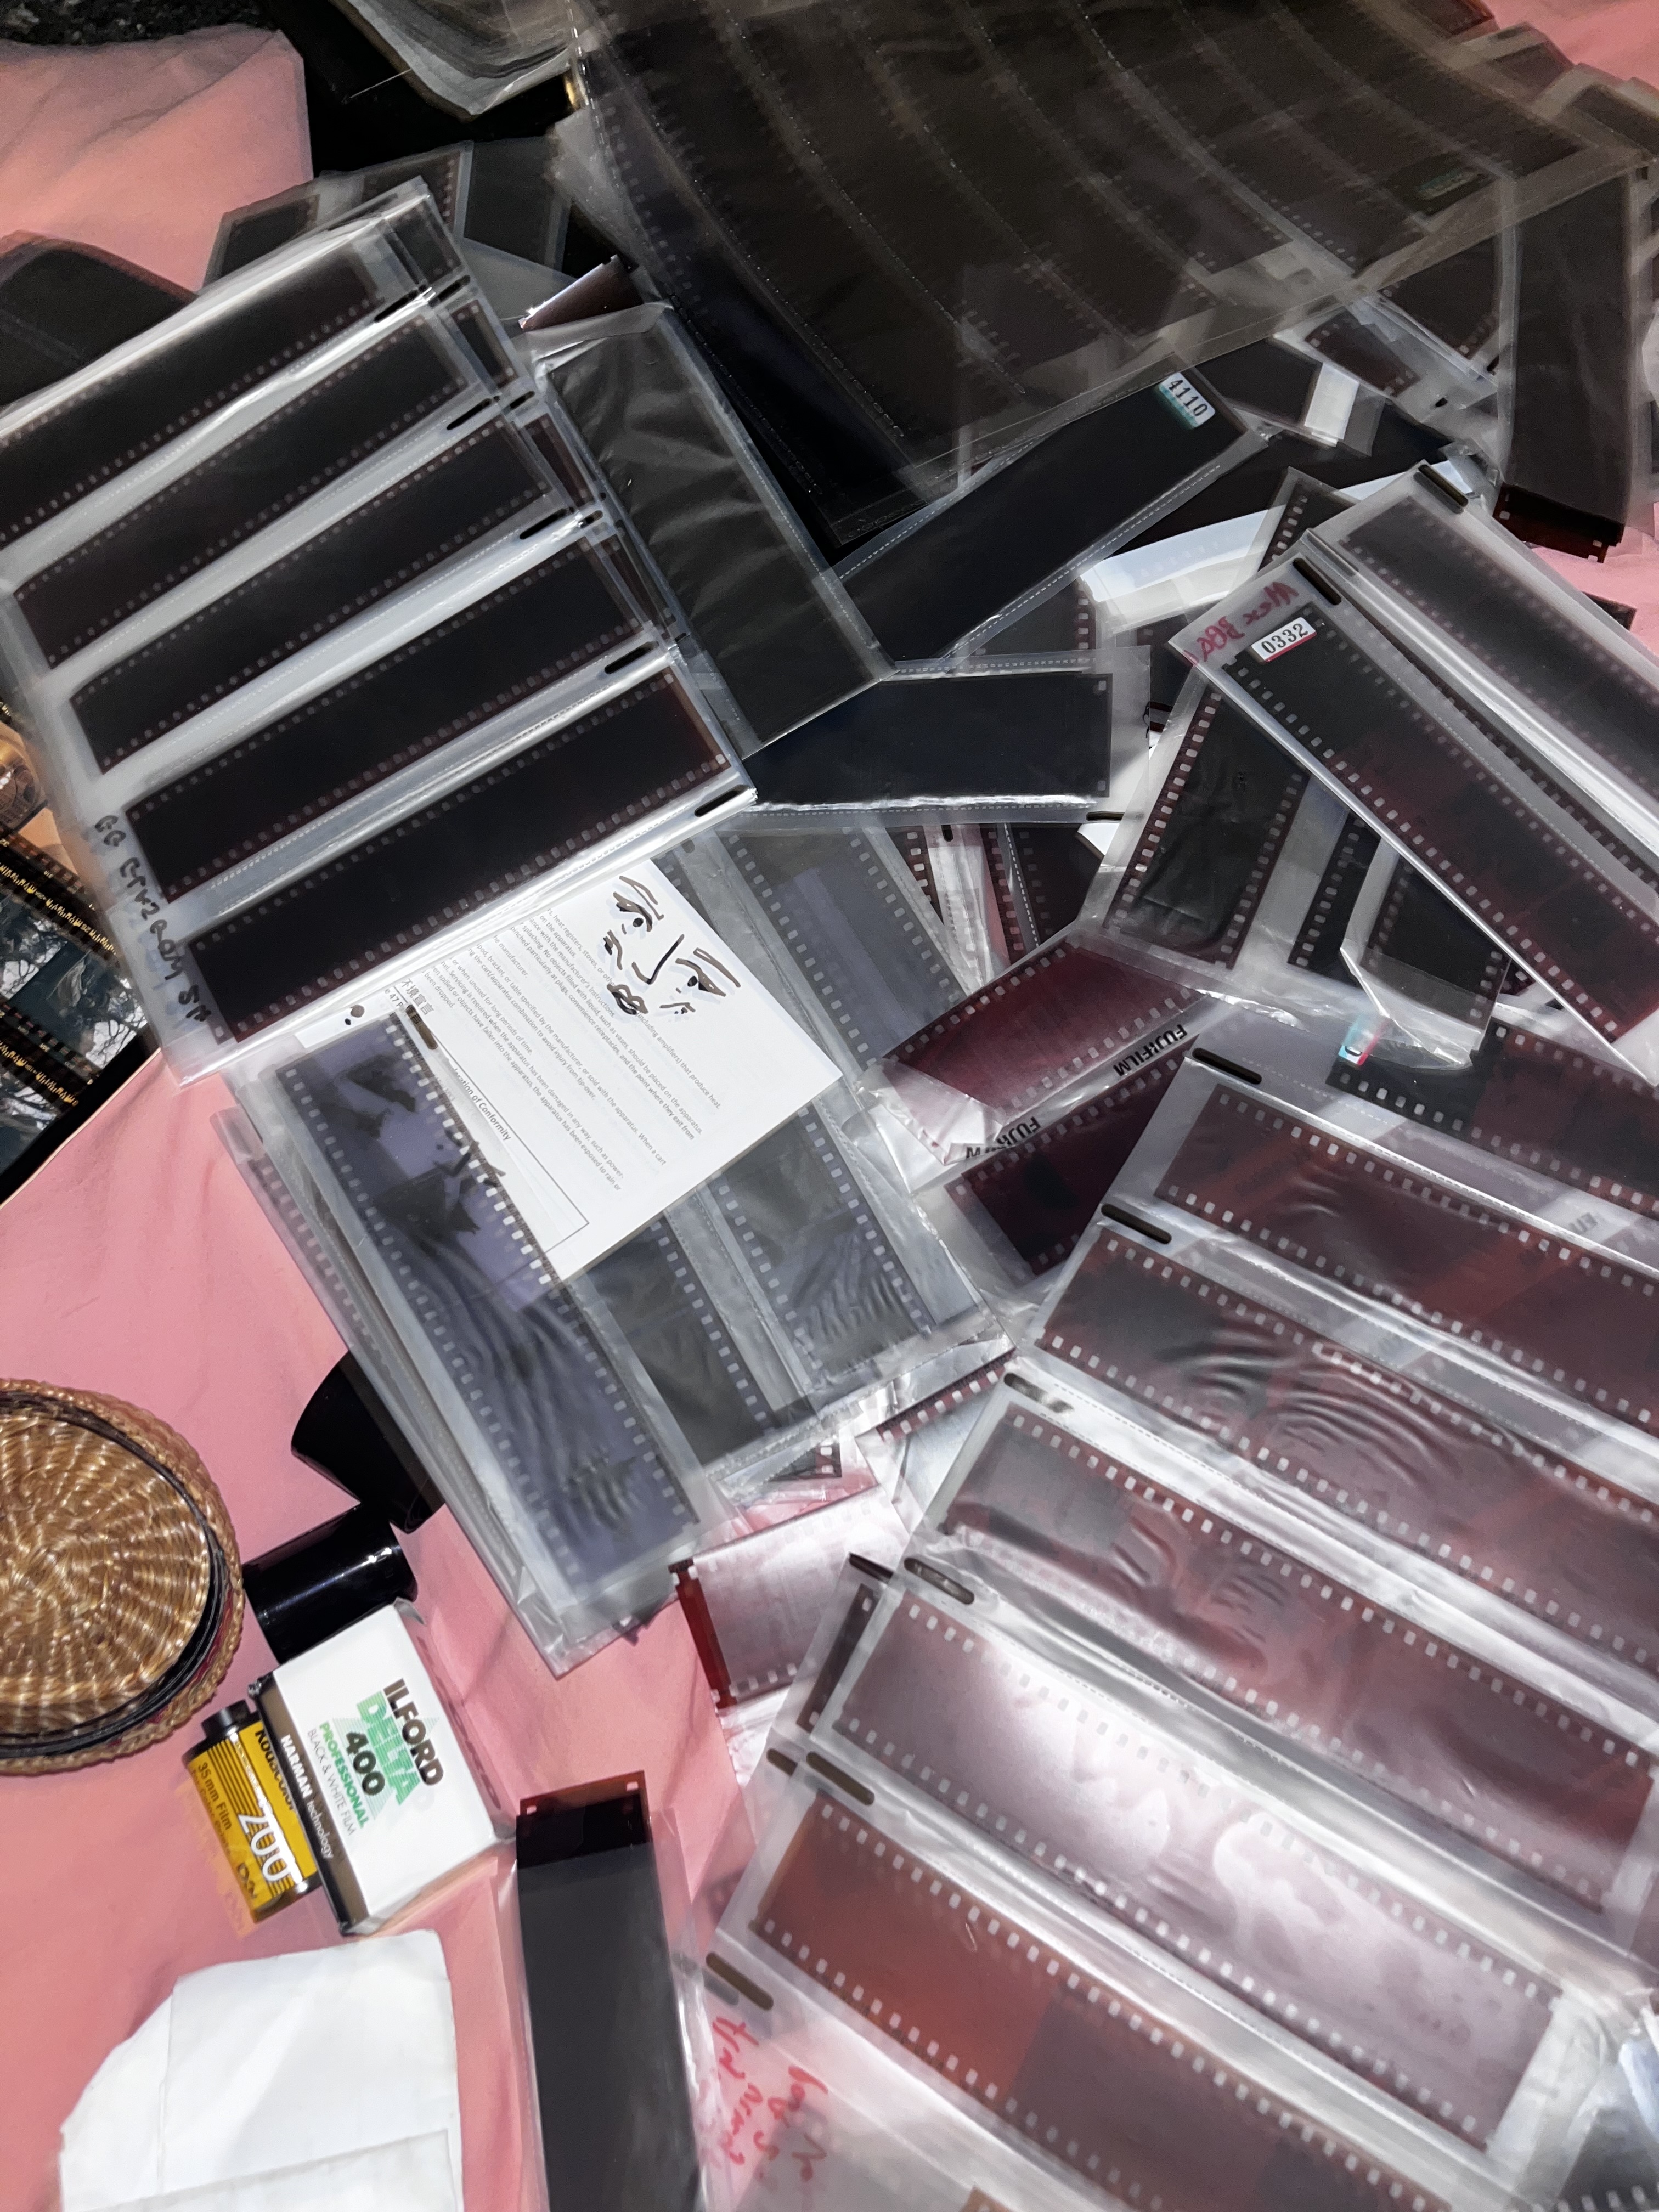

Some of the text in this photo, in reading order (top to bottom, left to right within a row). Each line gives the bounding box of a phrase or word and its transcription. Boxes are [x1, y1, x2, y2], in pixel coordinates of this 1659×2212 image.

[1168, 379, 1209, 417] 4110
[1261, 623, 1308, 653] 0332
[424, 972, 436, 986] been
[434, 985, 455, 1008] dropped.
[498, 943, 528, 978] manufacturer.
[540, 930, 551, 943] with
[549, 941, 558, 952] the
[588, 986, 615, 1018] instructions.
[545, 922, 555, 932] the
[552, 931, 575, 958] apparatus.
[448, 970, 469, 994] Servicing
[470, 997, 492, 1019] required
[488, 1018, 501, 1033] when
[500, 1032, 509, 1042] the
[507, 1041, 530, 1067] apparatus
[528, 1065, 538, 1076] has
[536, 1075, 549, 1089] been
[547, 1088, 569, 1113] damaged
[571, 1118, 582, 1128] any
[580, 1127, 591, 1141] way,
[590, 1140, 603, 1153] such
[457, 965, 470, 980] when
[469, 979, 487, 998] unused
[483, 997, 492, 1005] for
[490, 1005, 502, 1018] long
[499, 1017, 517, 1036] periods
[521, 1041, 532, 1055] time.
[473, 955, 482, 964] the
[481, 964, 512, 1001] cart/apparatus
[510, 1000, 538, 1031] combination
[541, 1036, 556, 1051] avoid
[553, 1049, 568, 1065] injury
[566, 1064, 578, 1079] from
[487, 955, 505, 977] bracket,
[509, 982, 522, 996] table
[520, 995, 542, 1018] specified
[539, 1016, 546, 1025] by
[544, 1024, 554, 1034] the
[552, 1033, 583, 1069] manufacturer,
[587, 1074, 600, 1086] sold
[597, 1085, 608, 1098] with
[607, 1097, 616, 1107] the
[614, 1107, 637, 1133] apparatus.
[638, 1132, 653, 1150] When
[654, 1154, 666, 1165] cart
[509, 926, 530, 947] pinched
[554, 979, 568, 995] plugs,
[568, 994, 596, 1025] convenience
[619, 1054, 631, 1065] and
[628, 1064, 637, 1074] the
[635, 1074, 650, 1088] point
[648, 1087, 664, 1104] where
[662, 1103, 674, 1116] they
[673, 1116, 683, 1127] exit
[681, 1125, 694, 1140] from
[543, 949, 551, 958] No
[550, 957, 566, 976] objects
[565, 974, 579, 989] filled
[575, 988, 587, 1000] with
[585, 998, 601, 1016] liquid,
[599, 1015, 611, 1028] such
[615, 1033, 629, 1049] vases,
[628, 1048, 646, 1066] should
[642, 1065, 651, 1074] be
[648, 1073, 667, 1091] placed
[664, 1090, 672, 1098] on
[670, 1097, 680, 1107] the
[678, 1107, 702, 1134] apparatus.
[552, 915, 565, 928] heat
[562, 927, 583, 951] registers,
[582, 950, 597, 968] stoves,
[657, 1036, 682, 1064] amplifiers)
[680, 1062, 691, 1075] that
[689, 1074, 709, 1096] produce
[708, 1094, 720, 1109] heat.
[1113, 1024, 1188, 1076] FUJIFILM
[438, 974, 455, 991] spilled
[457, 997, 473, 1015] objects
[471, 1013, 484, 1028] have
[482, 1026, 495, 1041] fallen
[493, 1040, 504, 1052] into
[503, 1051, 512, 1061] the
[510, 1060, 533, 1088] apparatus,
[532, 1086, 541, 1096] the
[540, 1096, 563, 1122] apparatus
[561, 1120, 571, 1131] has
[569, 1130, 582, 1145] been
[580, 1144, 602, 1167] exposed
[604, 1173, 615, 1184] rain
[479, 1103, 511, 1141] Conformity
[307, 1729, 356, 1836] BLACK & WHITE FILM
[319, 1721, 369, 1829] PROFESSIONAL
[346, 1732, 385, 1796] 400
[357, 1690, 420, 1805] DELTA
[383, 1677, 444, 1786] ILFORD
[198, 1762, 232, 1830] 35 mm Film
[280, 1734, 334, 1858] HARMAN technology
